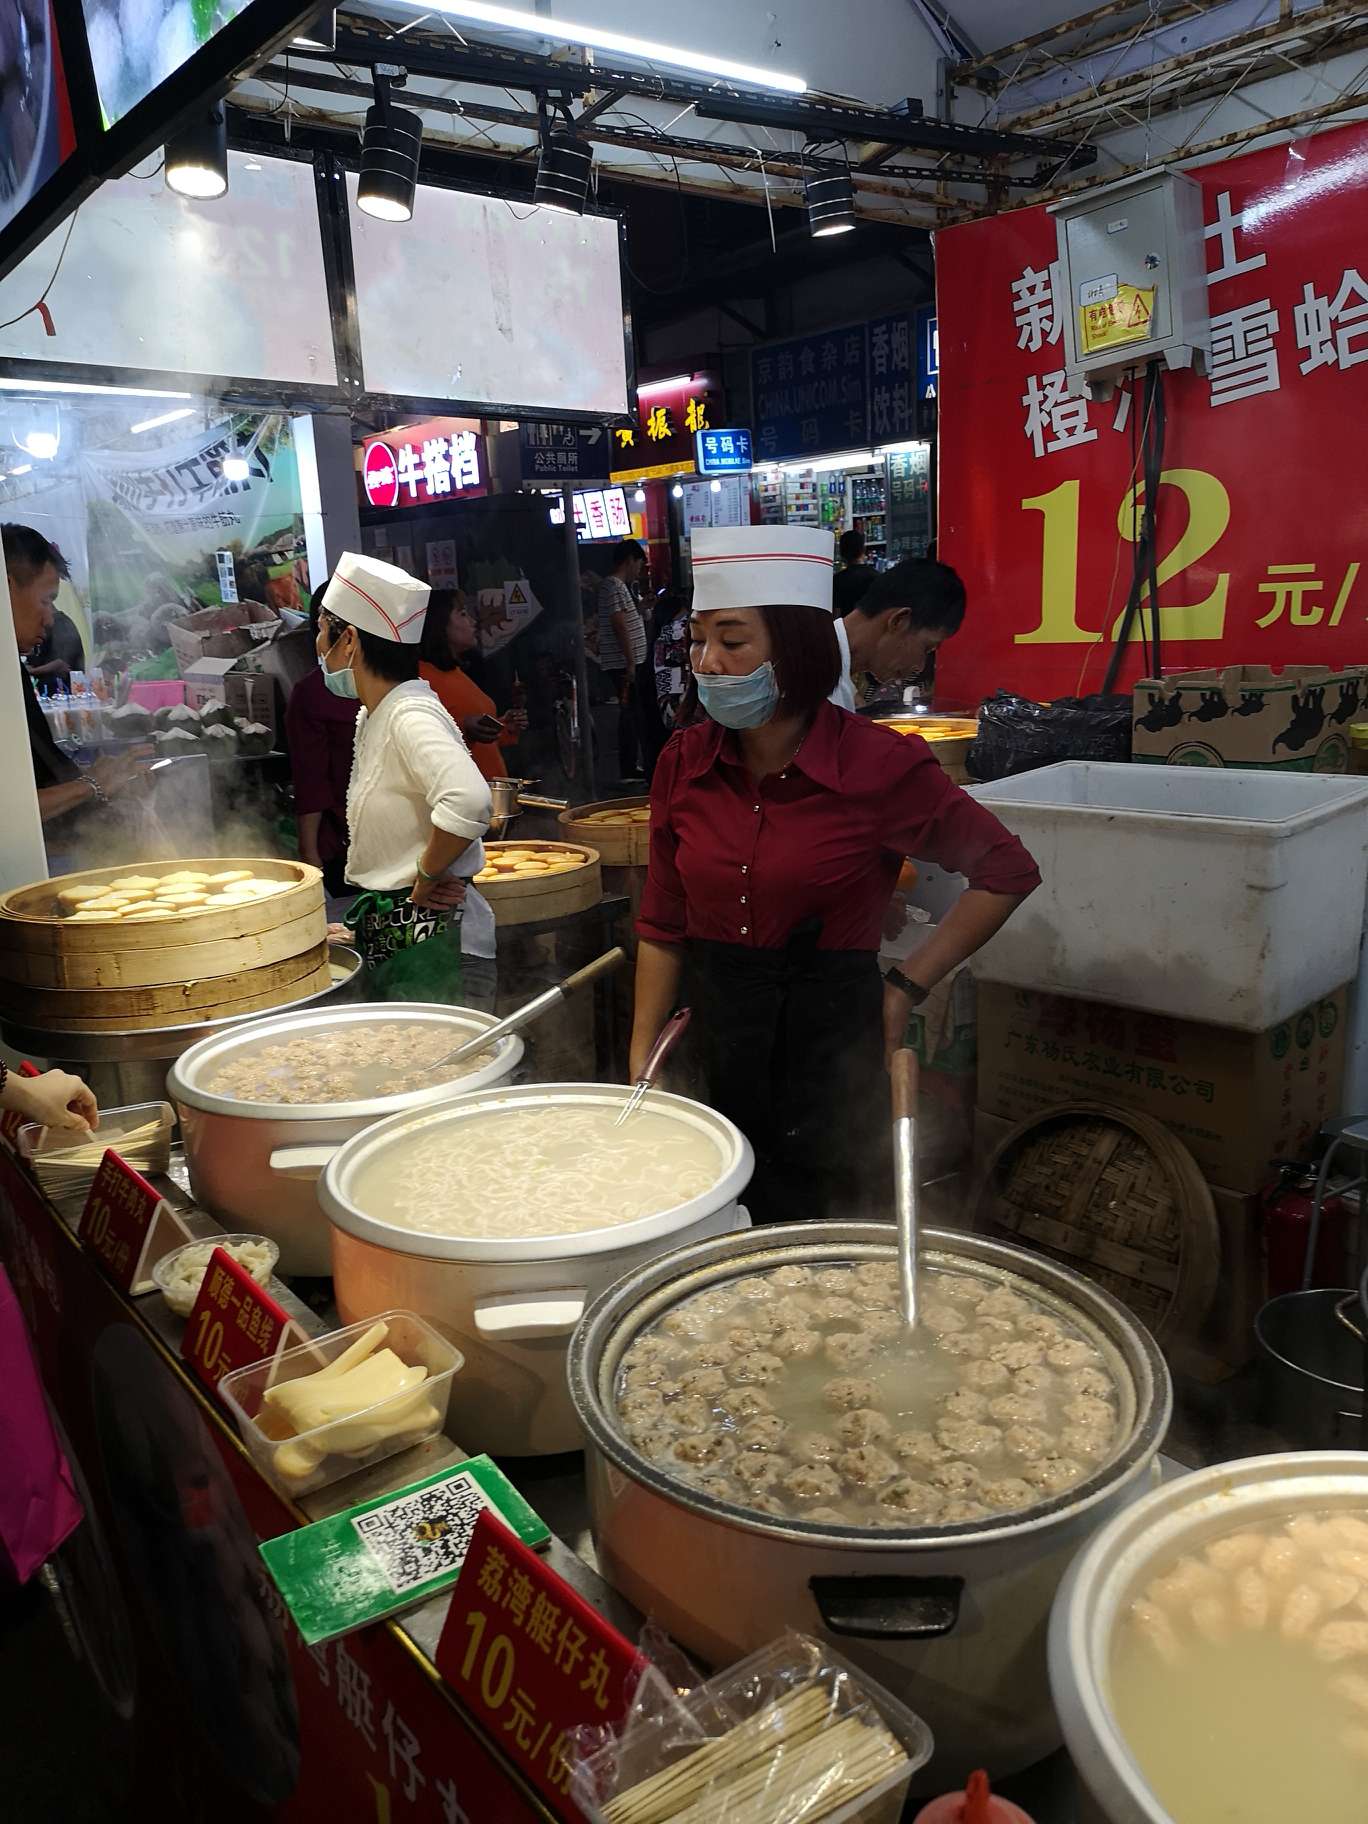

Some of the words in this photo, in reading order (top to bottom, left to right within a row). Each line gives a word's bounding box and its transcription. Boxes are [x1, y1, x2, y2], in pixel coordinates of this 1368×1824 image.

[1022, 269, 1368, 458] 橙雪蛤
[398, 431, 480, 497] 牛搭档
[534, 452, 578, 465] 公共厕所
[705, 435, 748, 454] 号码卡
[535, 464, 557, 472] Public
[558, 464, 578, 472] Toilet
[476, 1545, 610, 1710] 荔湾艇仔丸
